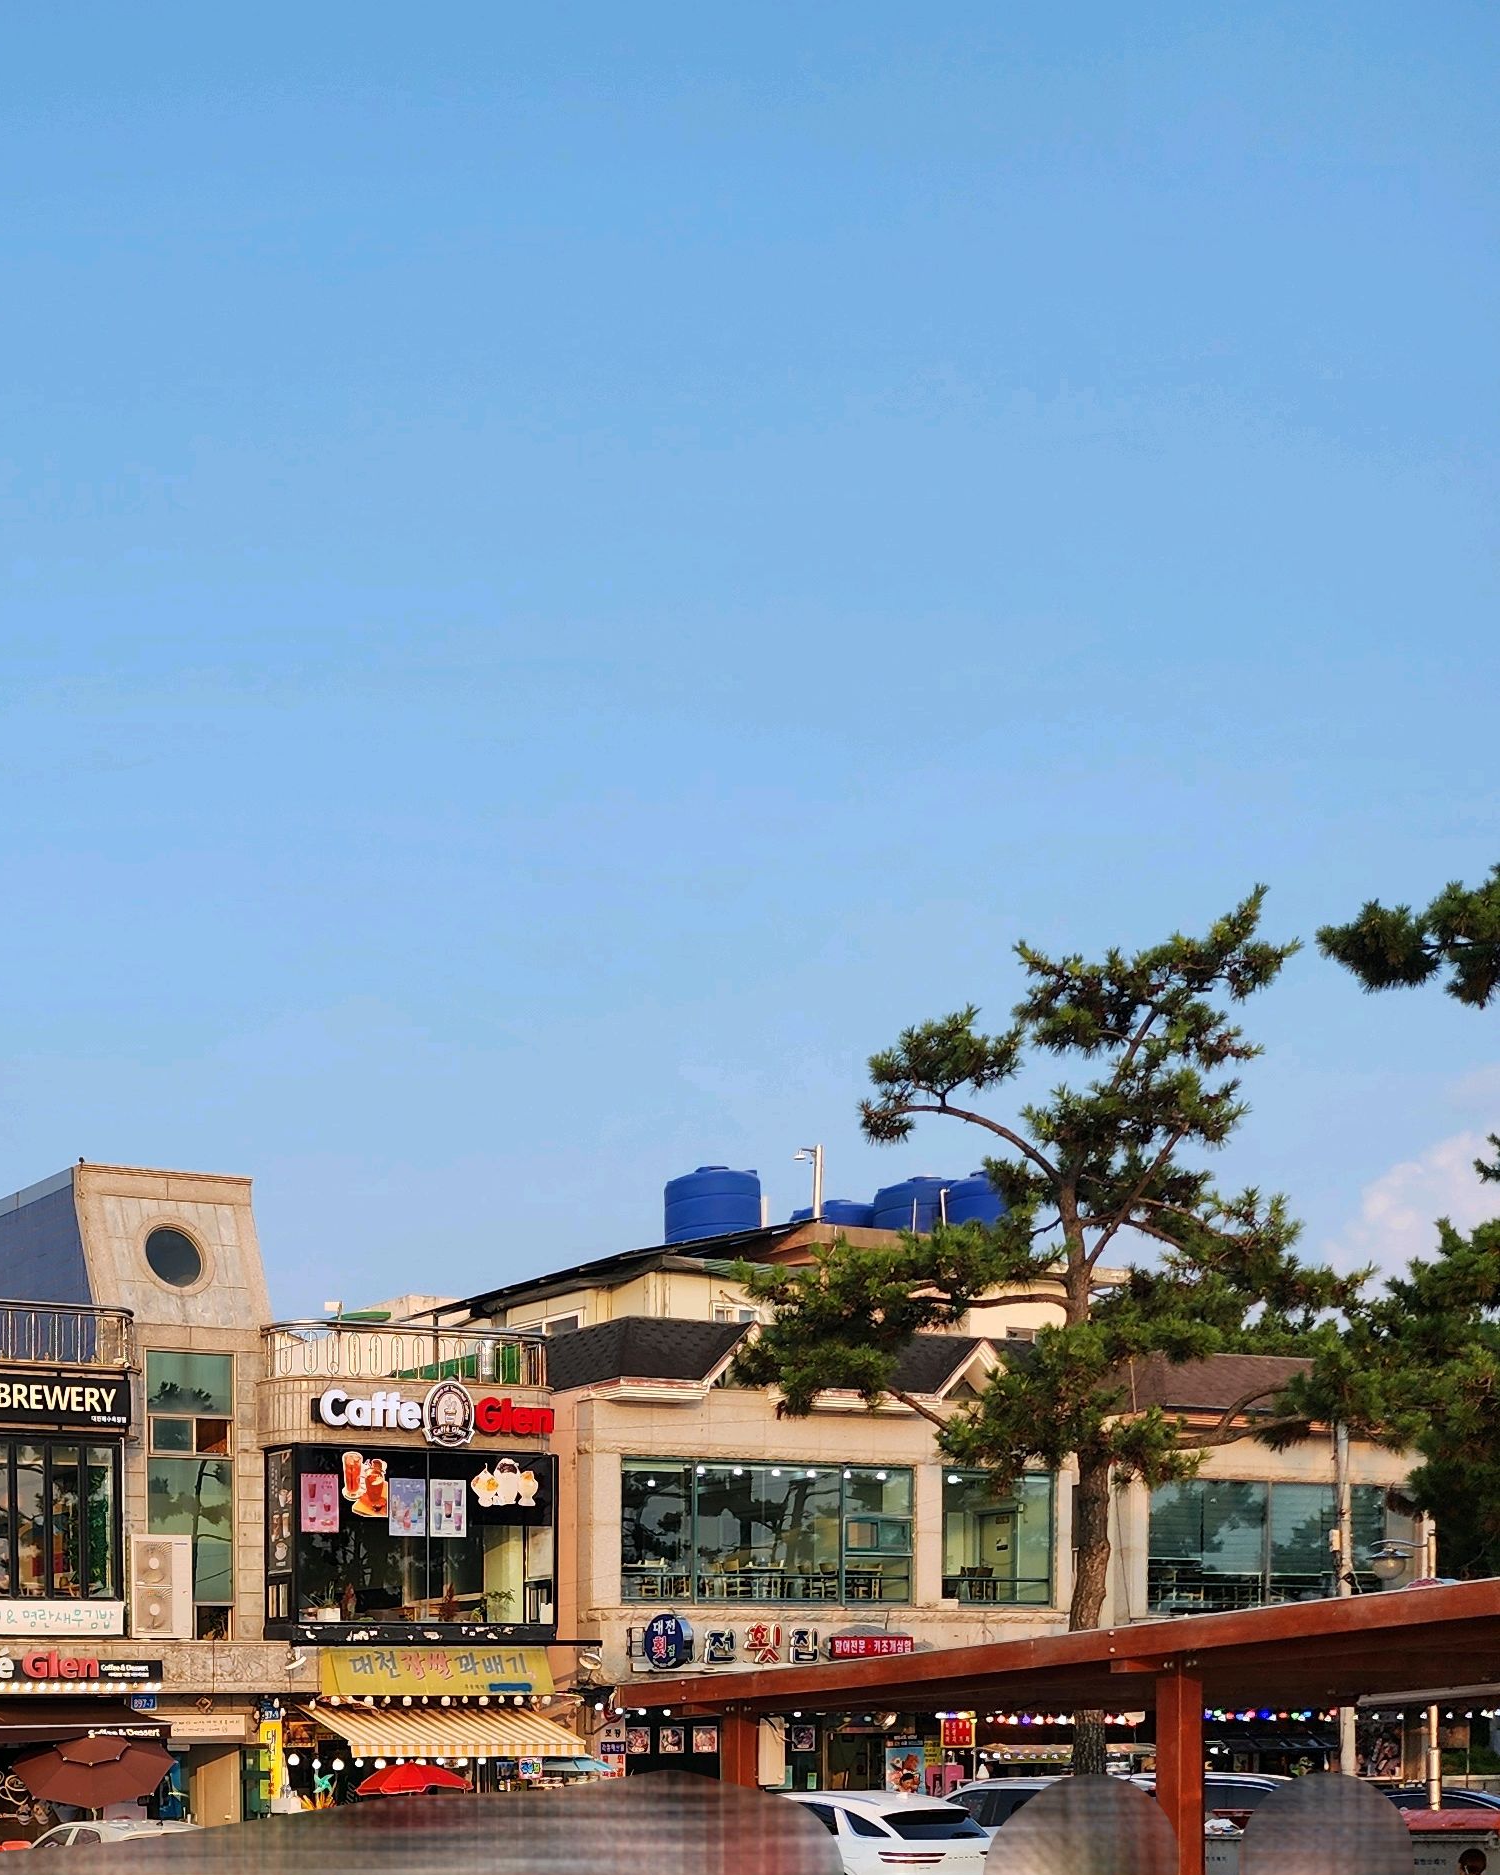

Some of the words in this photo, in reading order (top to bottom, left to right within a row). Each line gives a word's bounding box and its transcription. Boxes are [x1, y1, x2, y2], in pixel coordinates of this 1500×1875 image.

[475, 1396, 554, 1434] Glen
[23, 1609, 115, 1630] 명란새우김밥
[653, 1619, 675, 1634] 대전
[703, 1622, 820, 1664] 전횟집
[22, 1651, 100, 1680] Glen
[455, 1652, 527, 1676] 꽈배기
